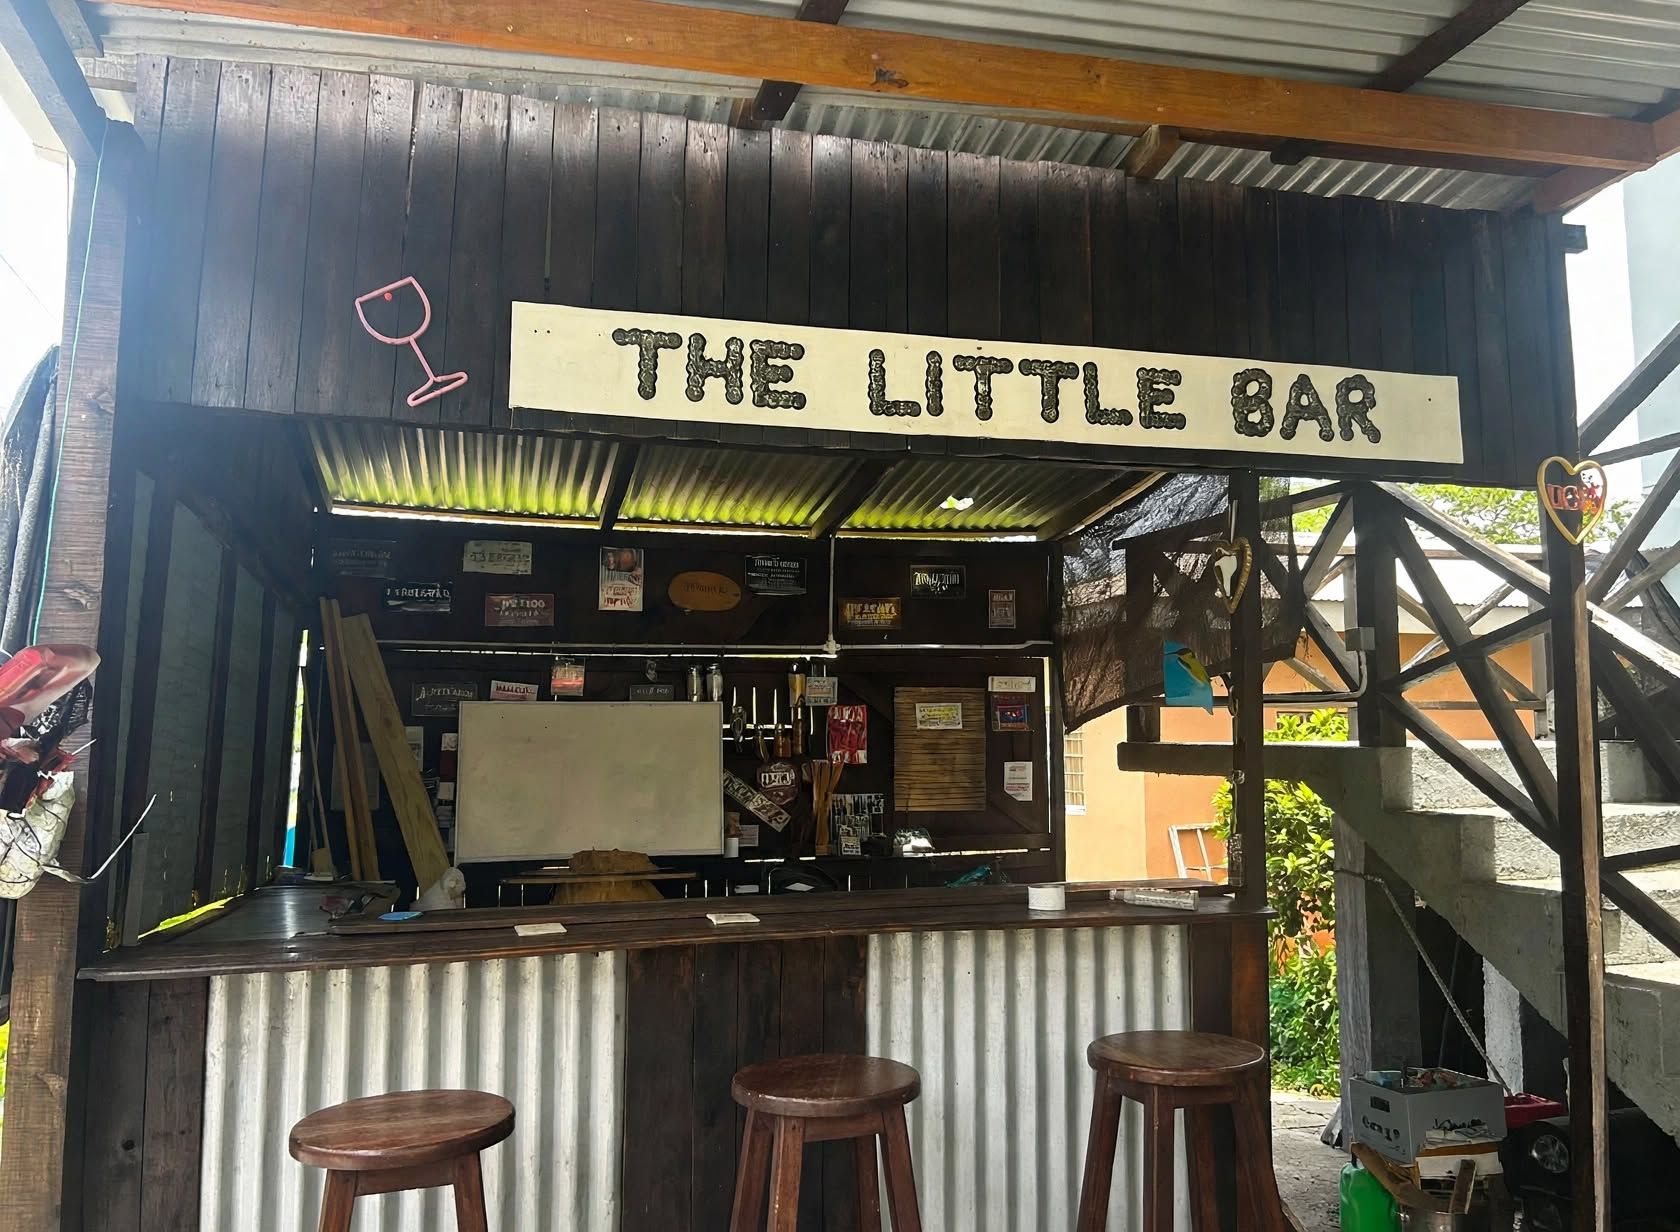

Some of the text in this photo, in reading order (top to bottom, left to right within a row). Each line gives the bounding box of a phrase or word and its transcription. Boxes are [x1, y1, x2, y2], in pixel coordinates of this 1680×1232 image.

[612, 328, 1381, 443] THE LITTLE BAR
